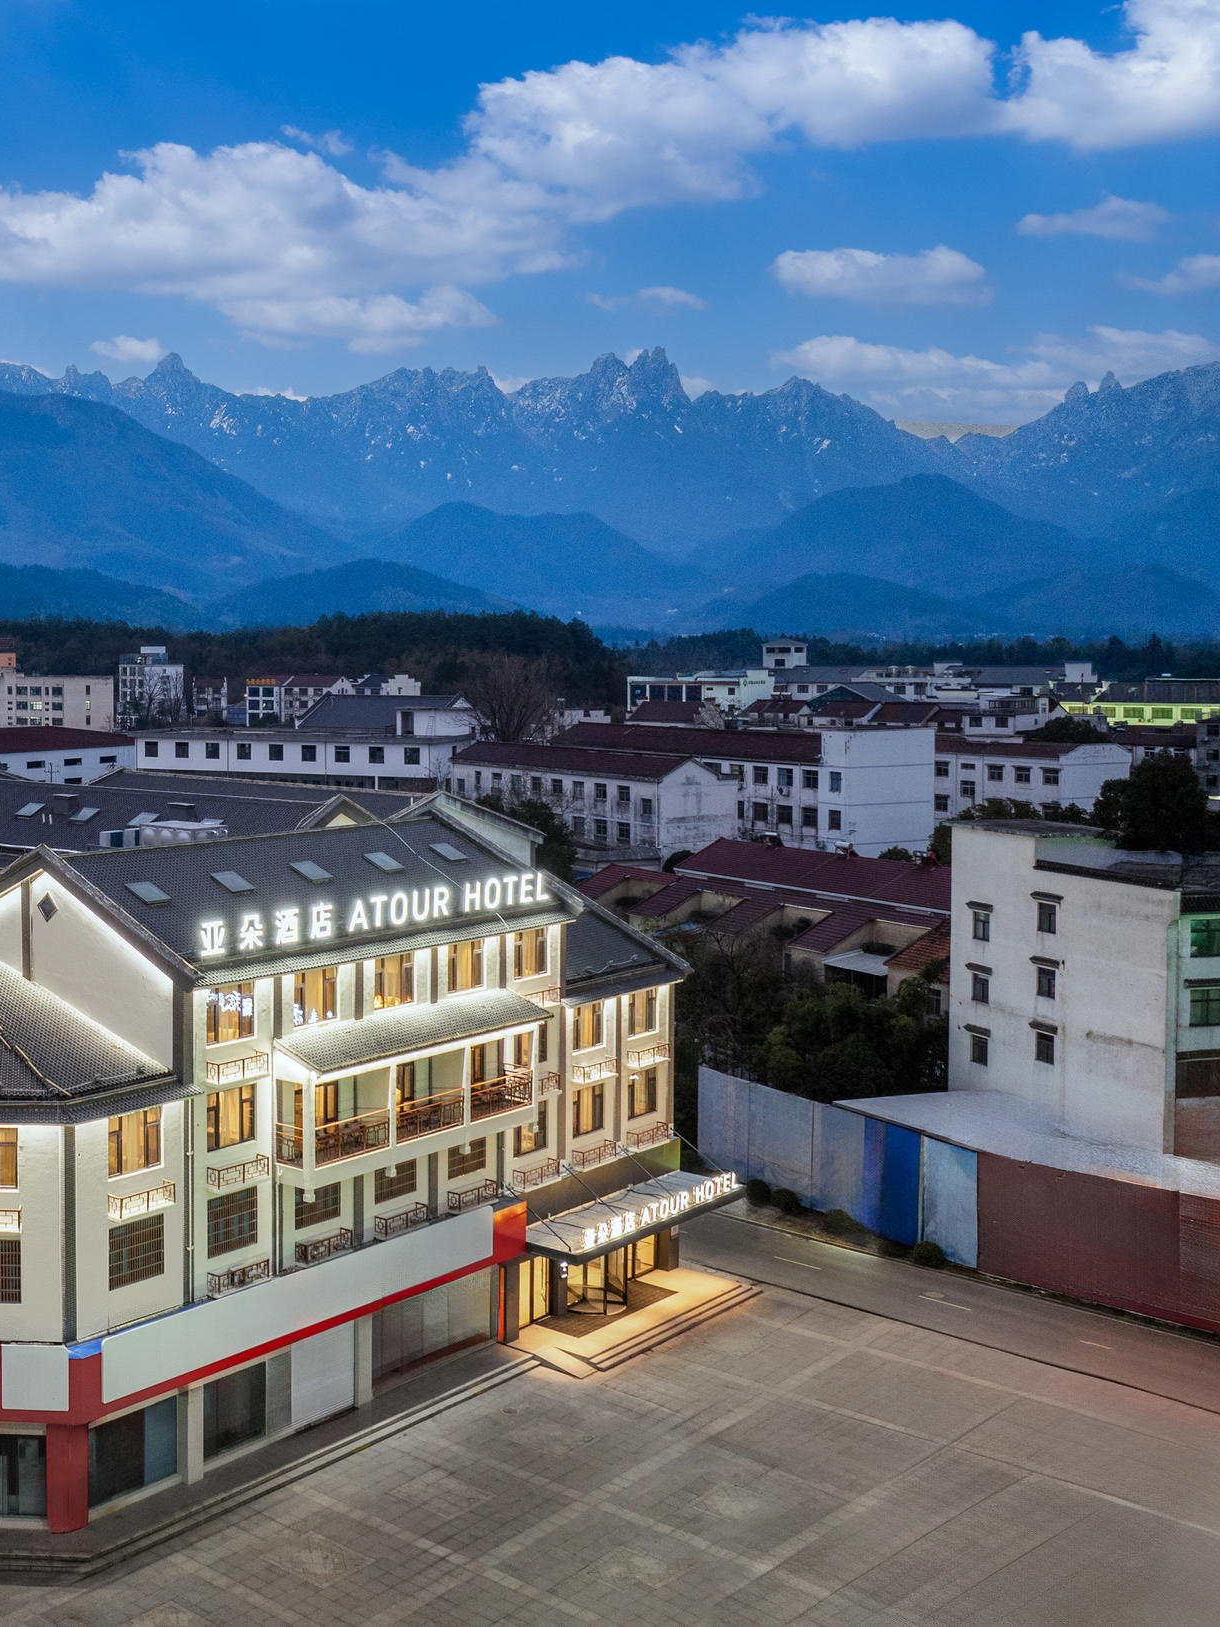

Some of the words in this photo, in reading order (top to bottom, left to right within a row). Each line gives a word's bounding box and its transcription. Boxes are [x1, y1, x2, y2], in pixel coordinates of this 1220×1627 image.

[200, 903, 333, 957] 亚朵酒店
[349, 886, 450, 934] ATOUR
[464, 872, 550, 912] HOTEL
[640, 1191, 689, 1226] ATOUR
[693, 1172, 739, 1203] HOTEL
